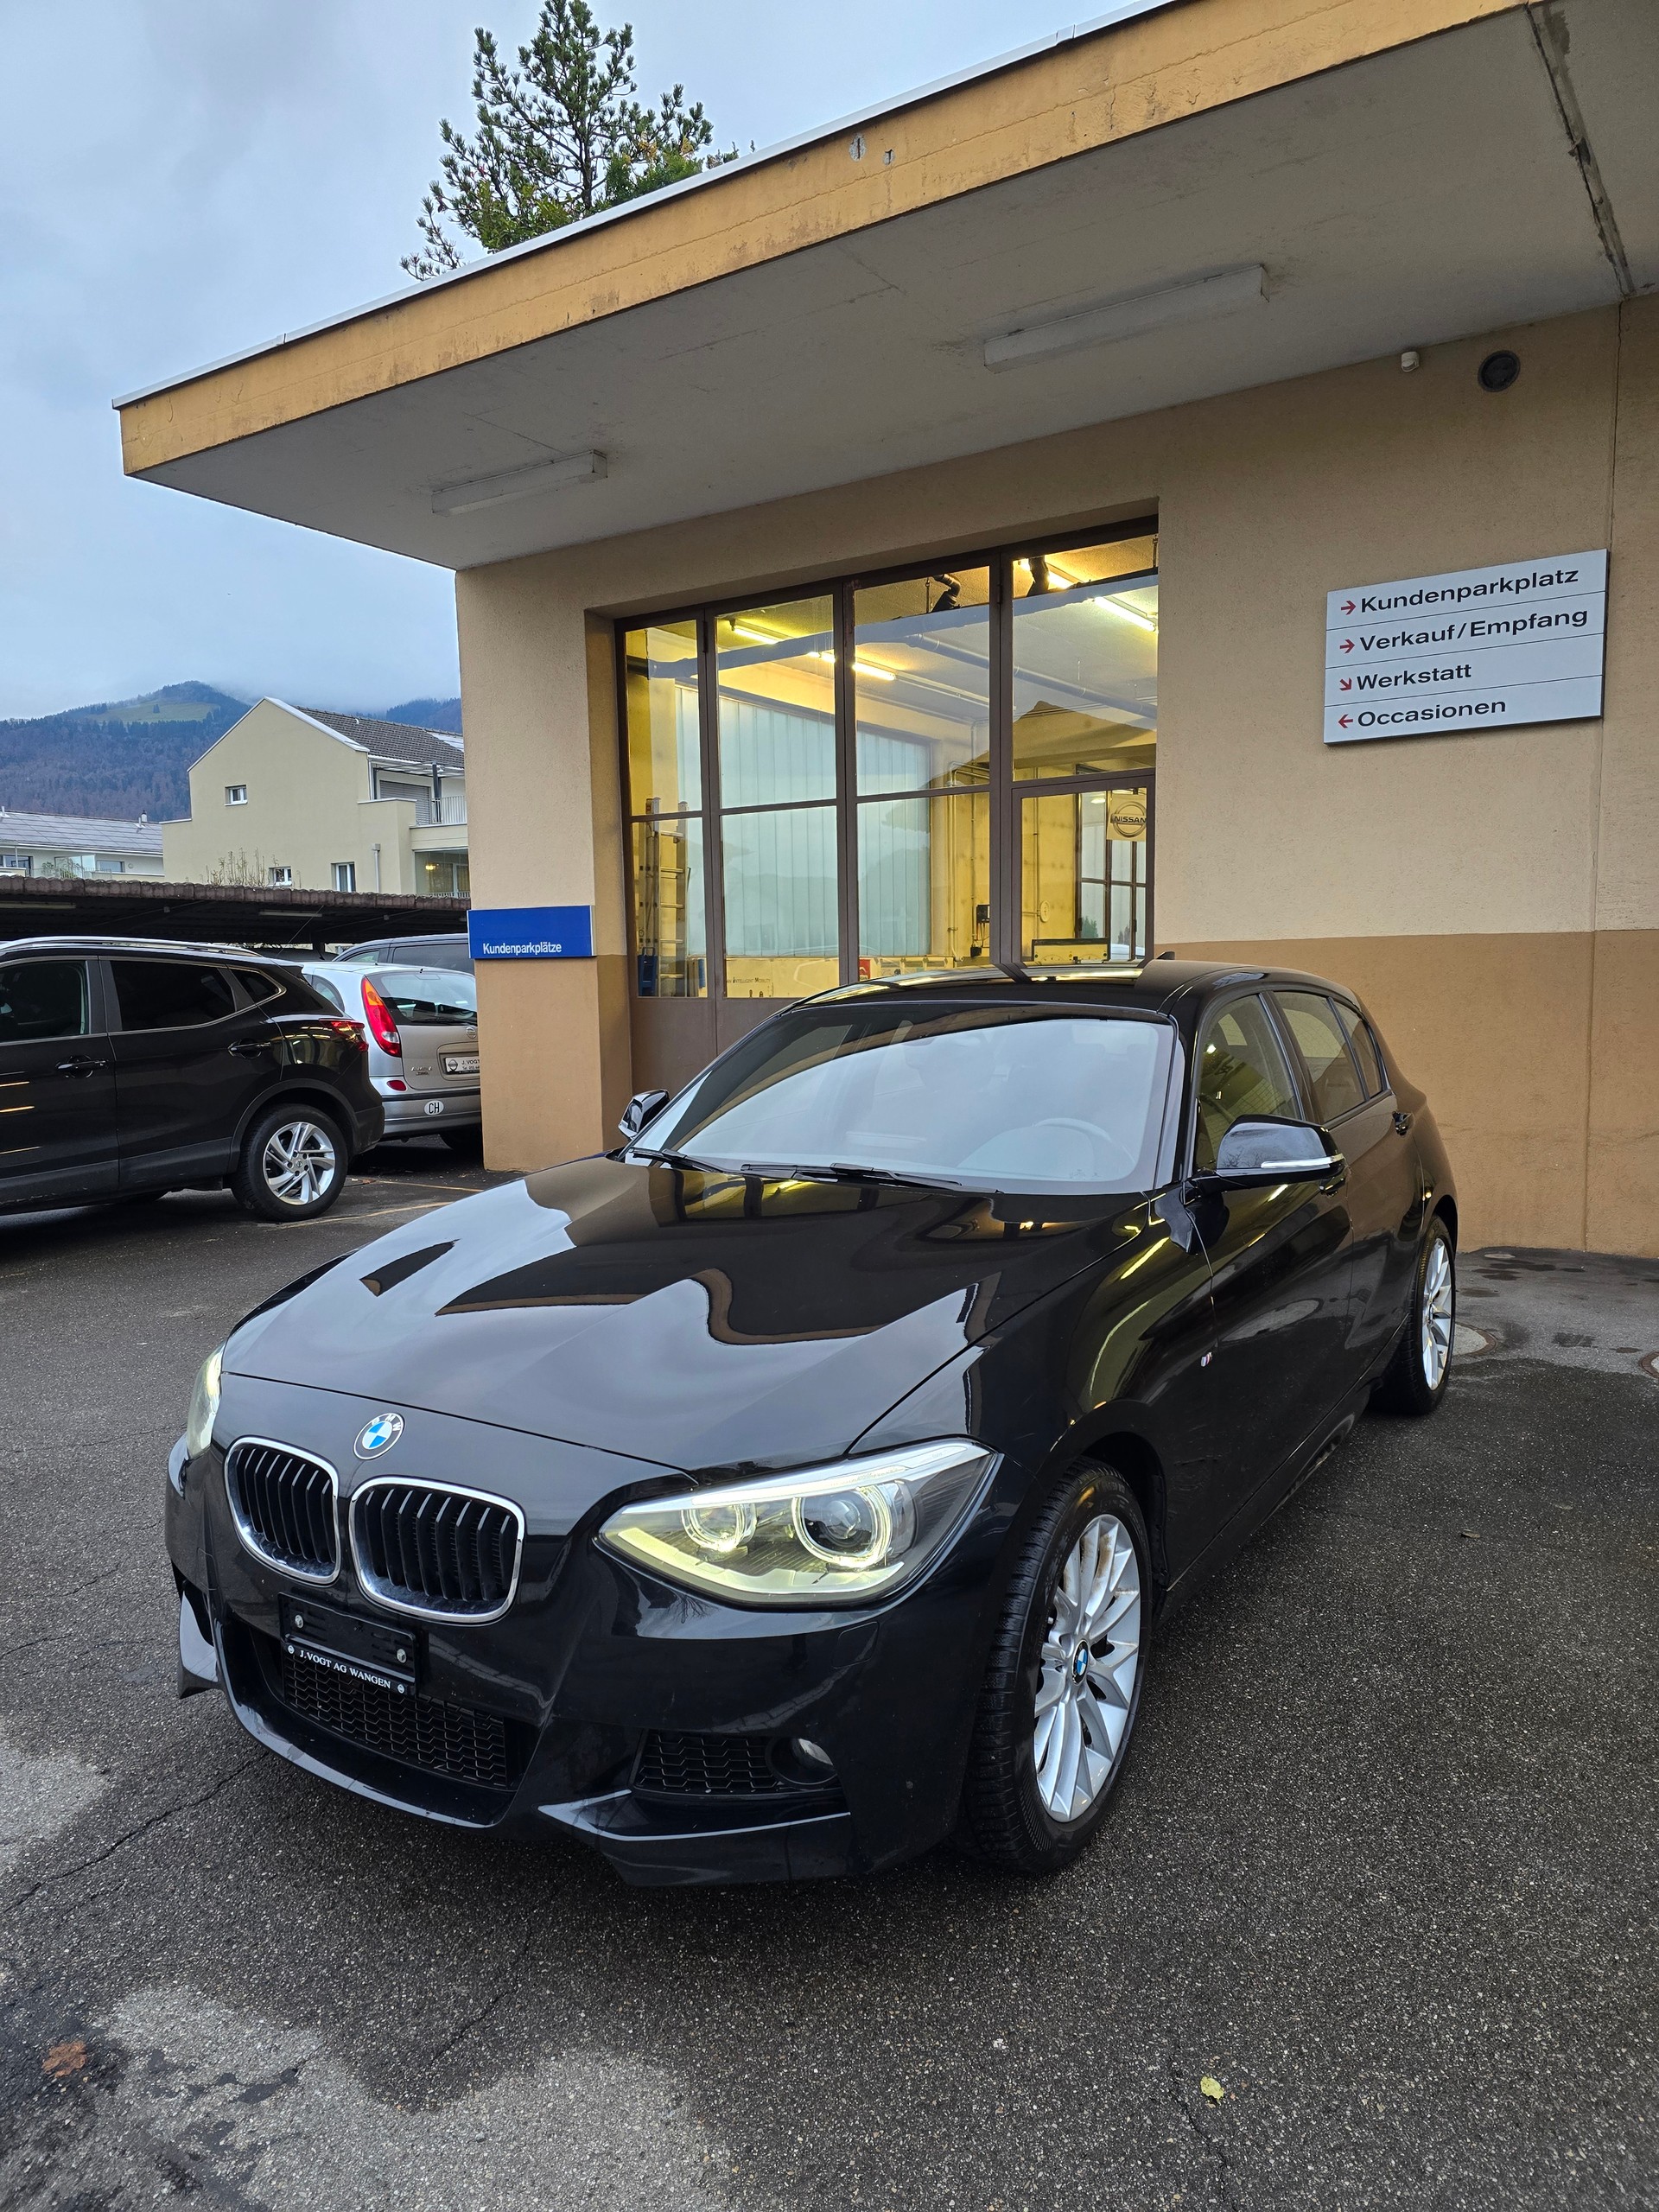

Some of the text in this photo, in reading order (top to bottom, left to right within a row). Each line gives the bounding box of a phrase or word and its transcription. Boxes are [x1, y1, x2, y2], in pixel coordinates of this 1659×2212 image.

[1361, 569, 1580, 613] Kundenparkplatz
[1359, 610, 1589, 652] Verkauf/Empfang
[1357, 664, 1472, 690] Werkstatt
[1357, 700, 1506, 727] Occasionen
[482, 941, 563, 956] Kundenparkplätze
[428, 1102, 440, 1115] CH
[333, 1662, 347, 1674] AG
[349, 1667, 391, 1689] WANGEN
